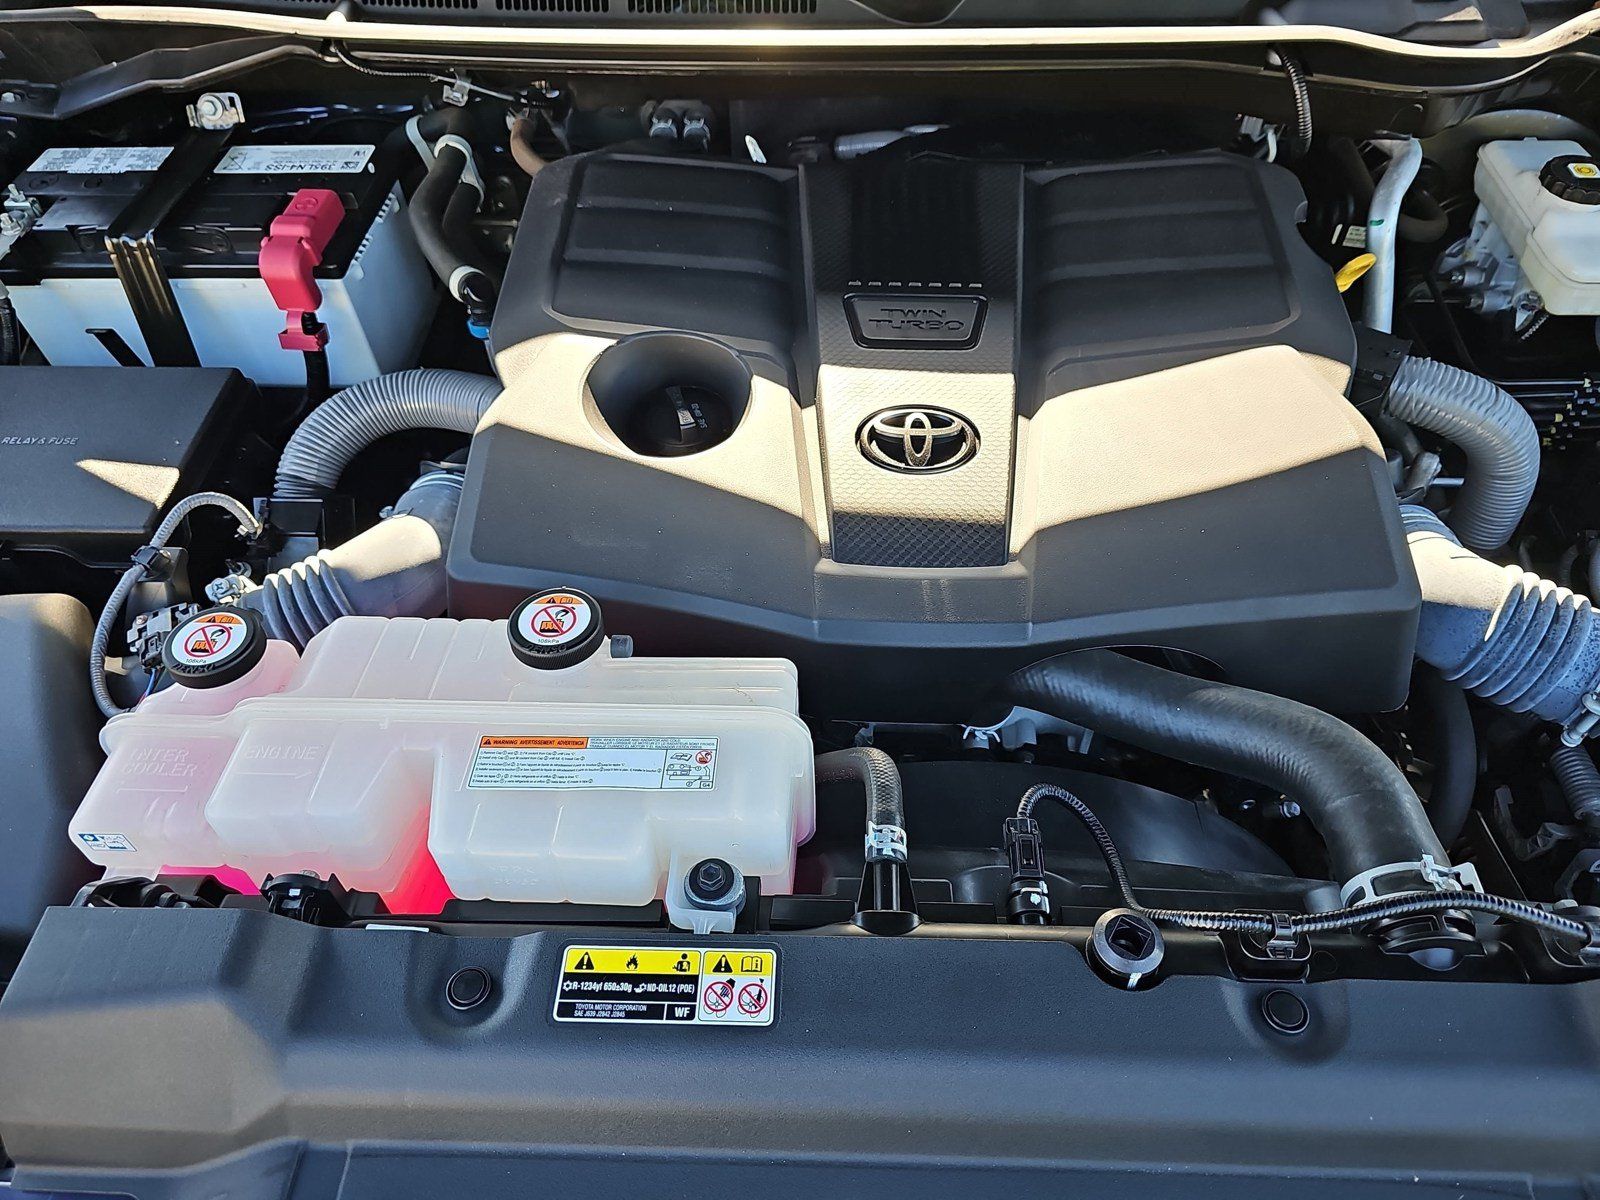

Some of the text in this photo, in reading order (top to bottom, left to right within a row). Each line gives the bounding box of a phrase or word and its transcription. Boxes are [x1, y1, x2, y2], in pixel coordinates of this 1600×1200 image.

[880, 308, 947, 318] TWIN
[868, 319, 965, 331] TURBO
[1, 436, 39, 445] RELAY
[48, 437, 79, 445] FUSE
[131, 748, 190, 762] INTER
[247, 745, 319, 760] ENGINE
[122, 762, 198, 777] COOLER
[572, 981, 602, 993] R-1234yf
[603, 982, 632, 993] 650±30g
[677, 984, 695, 994] (POE)
[612, 1004, 648, 1012] CORPORATION
[675, 1007, 690, 1018] WF
